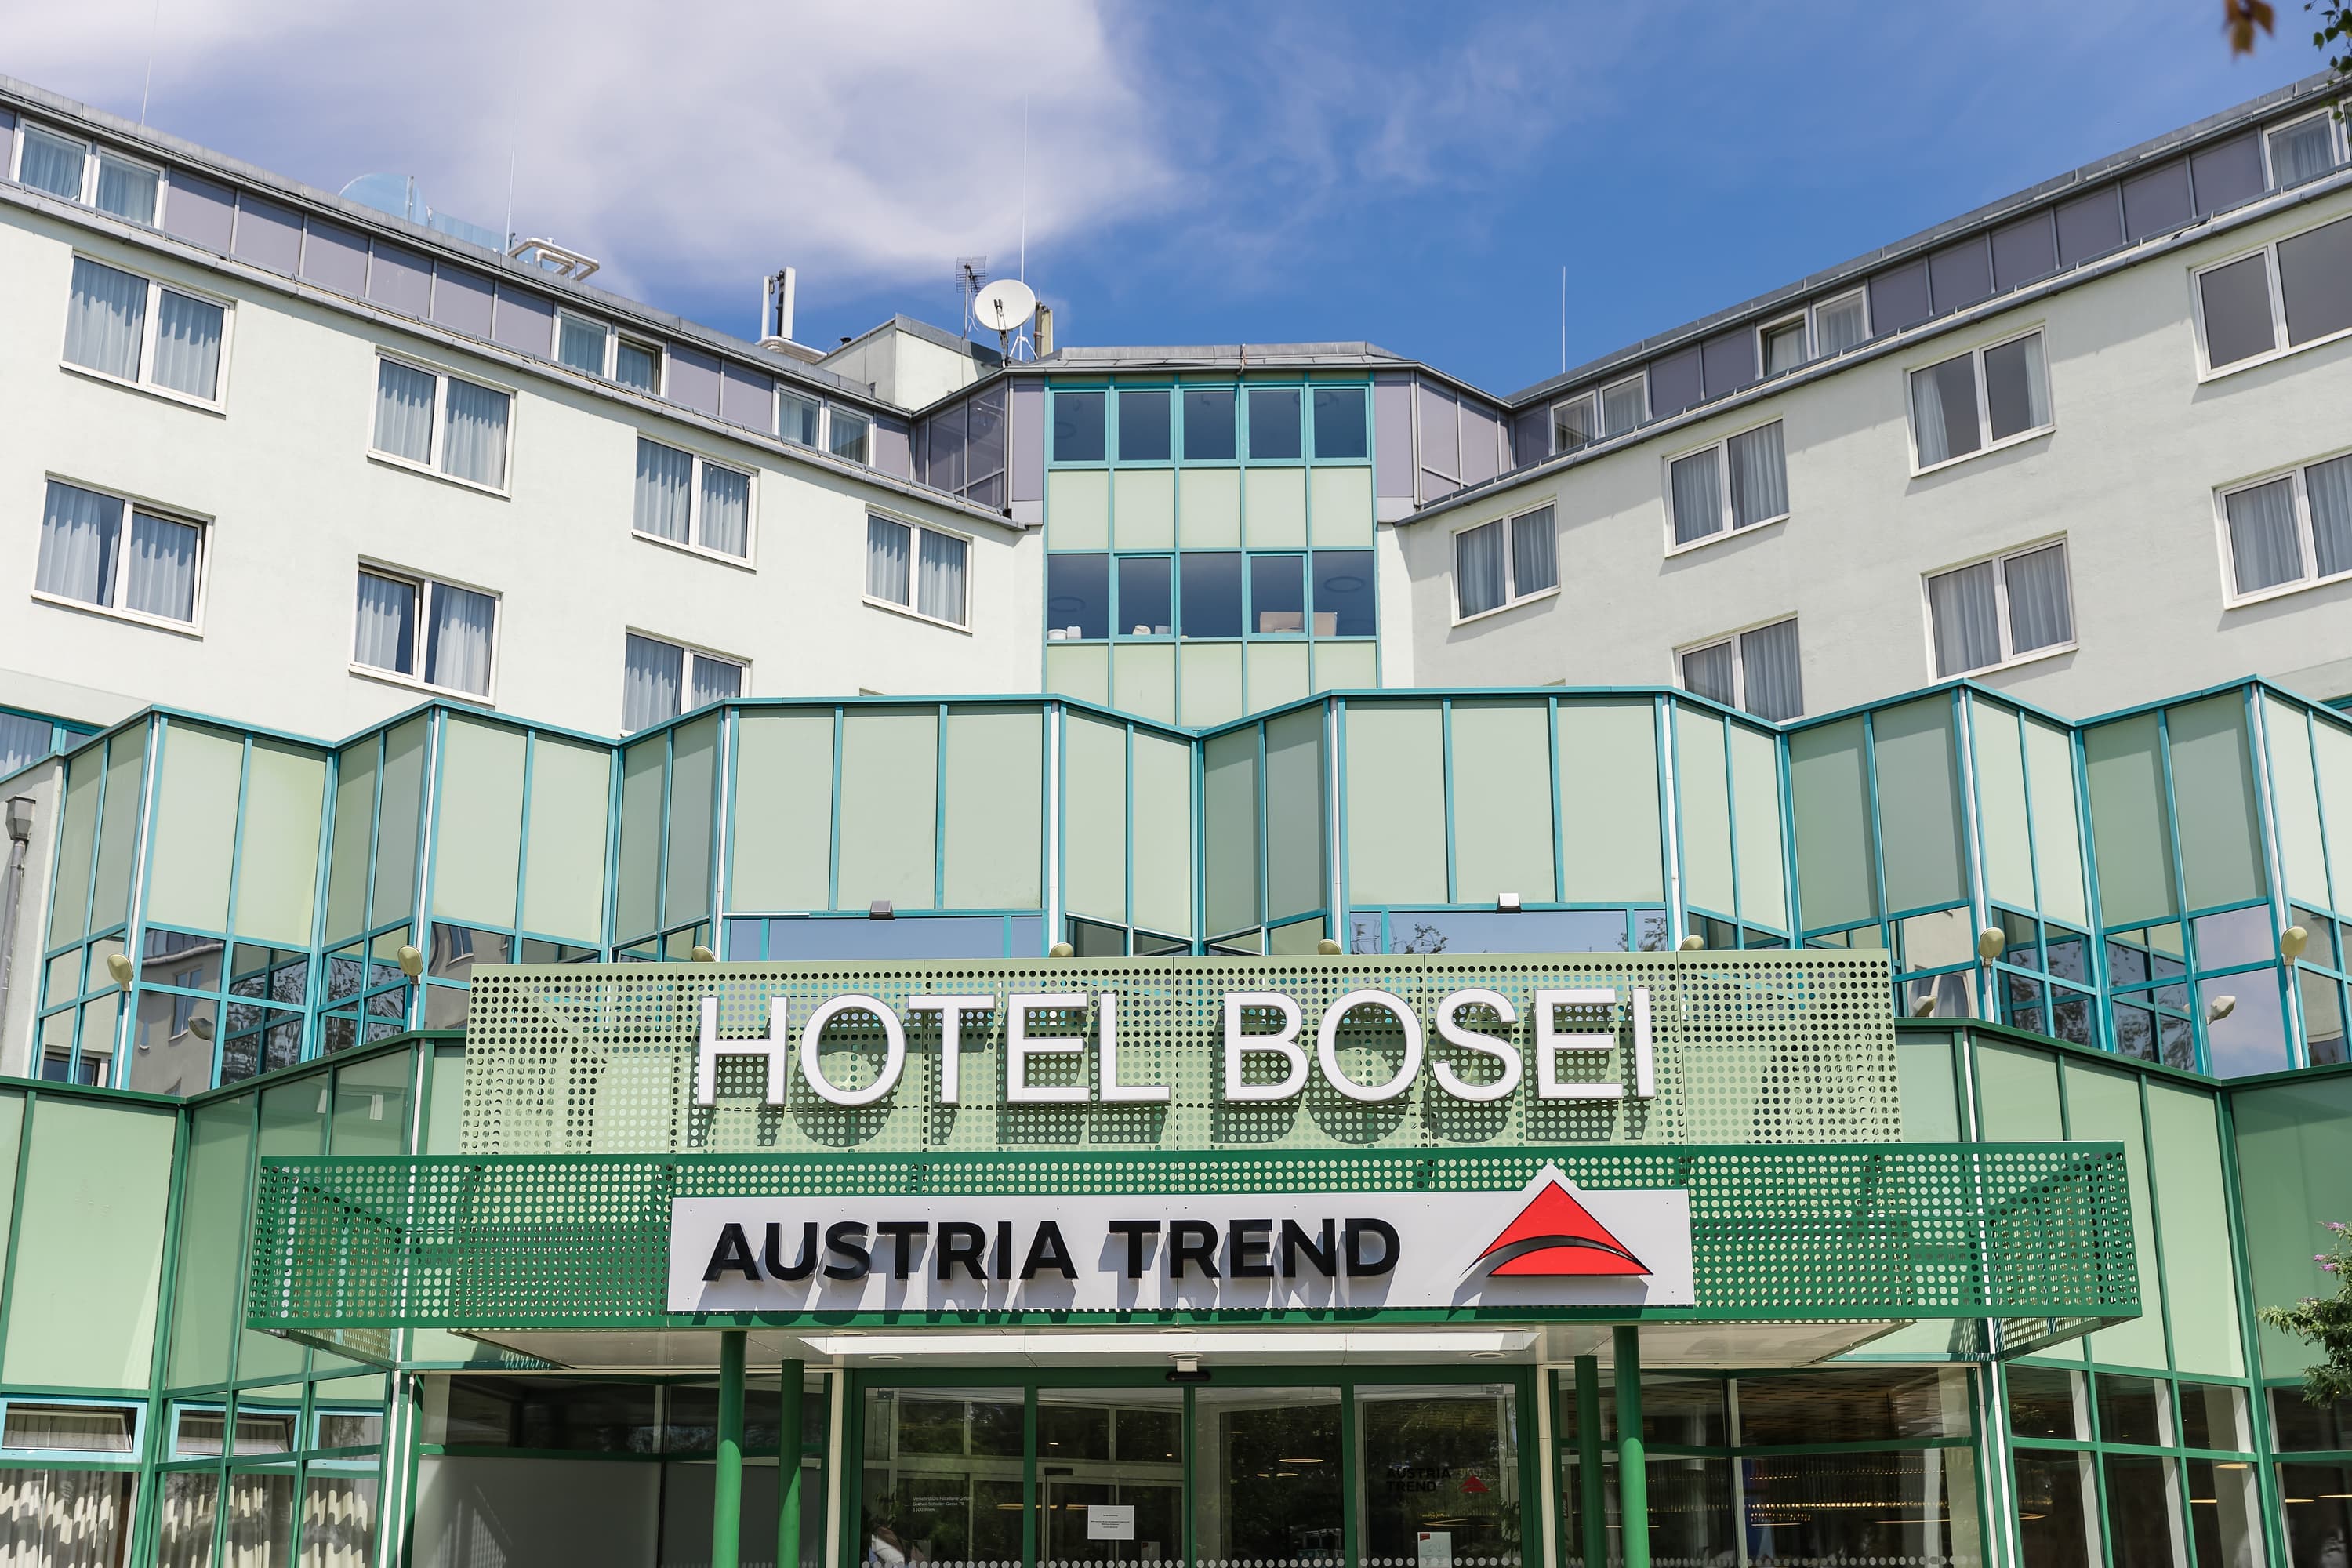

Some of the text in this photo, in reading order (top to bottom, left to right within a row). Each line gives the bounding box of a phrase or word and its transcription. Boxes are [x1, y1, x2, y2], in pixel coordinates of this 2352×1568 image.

[696, 987, 1656, 1107] HOTEL BOSEI
[702, 1218, 1401, 1282] AUSTRIA TREND
[1386, 1468, 1451, 1479] AUSTRIA
[1386, 1480, 1437, 1492] TREND
